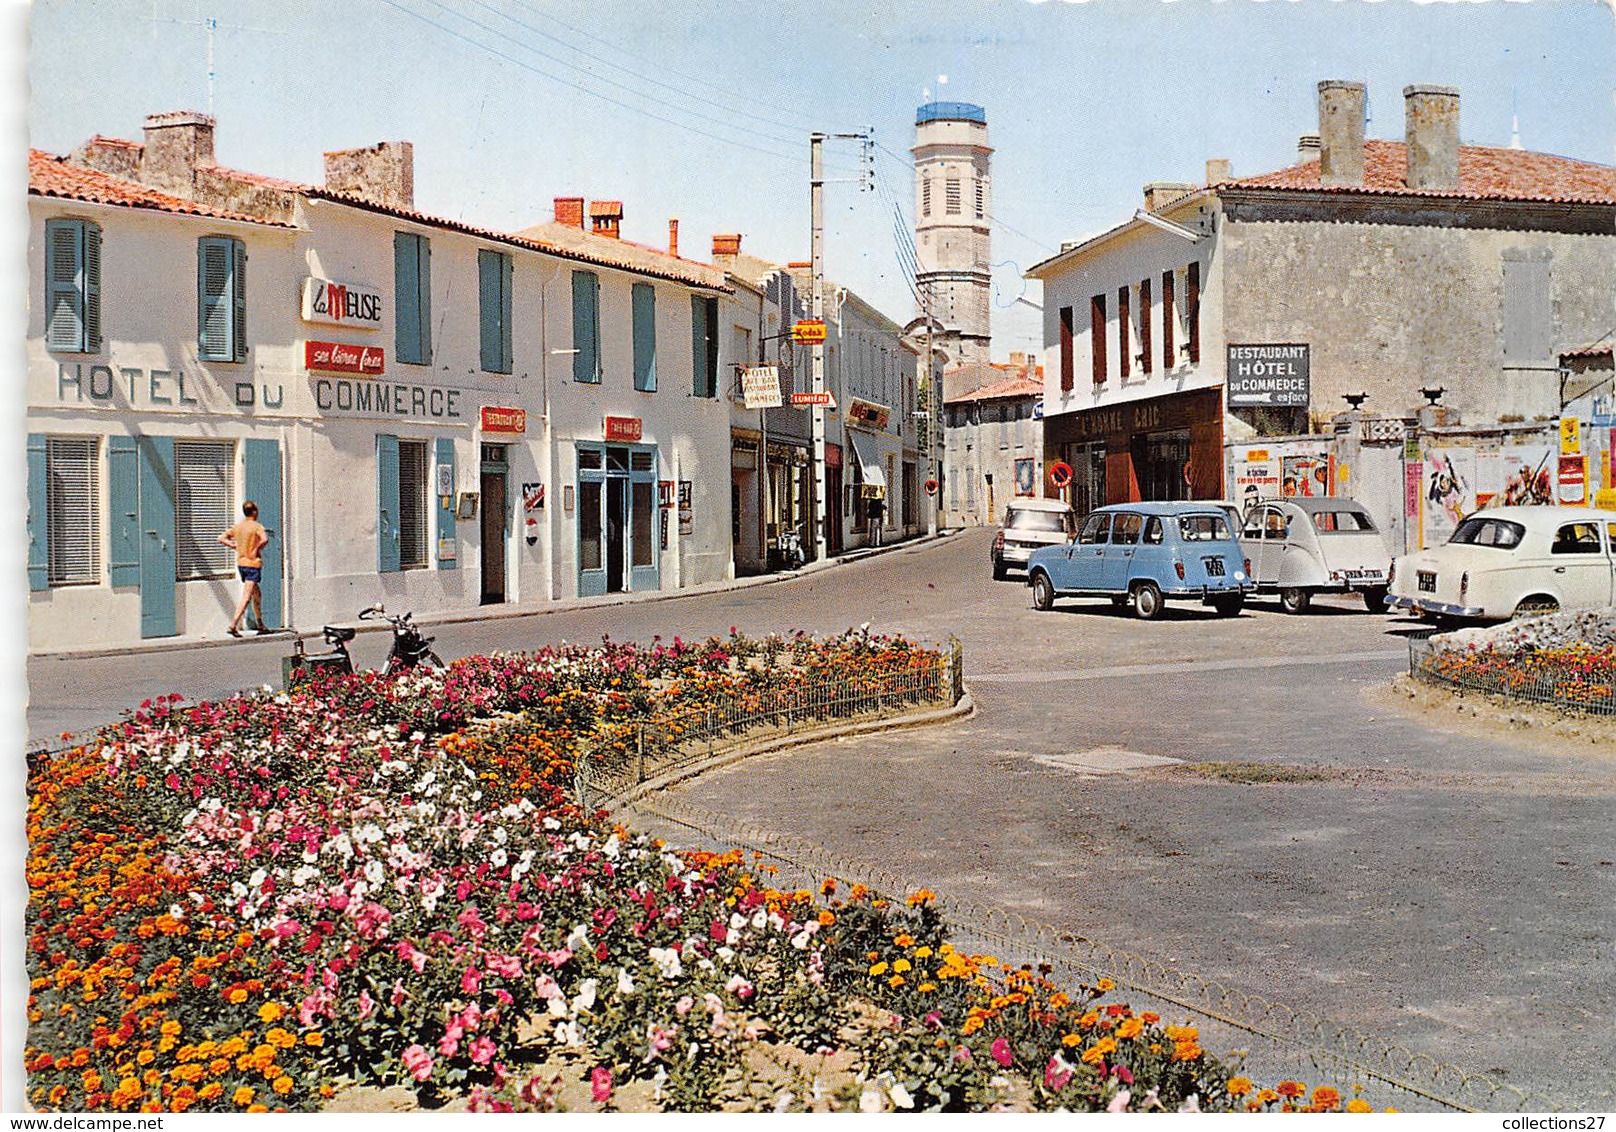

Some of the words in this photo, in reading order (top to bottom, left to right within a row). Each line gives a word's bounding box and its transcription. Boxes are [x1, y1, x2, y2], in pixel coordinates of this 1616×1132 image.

[313, 285, 328, 313] la
[328, 283, 381, 321] MEUSE
[796, 328, 822, 337] Kodak
[1230, 347, 1306, 359] RESTAURANT
[1238, 360, 1296, 375] HÔTEL
[58, 364, 197, 406] HOTEL
[235, 383, 283, 409] DU
[316, 380, 460, 417] COMMERCE
[1242, 379, 1305, 391] COMMERCE
